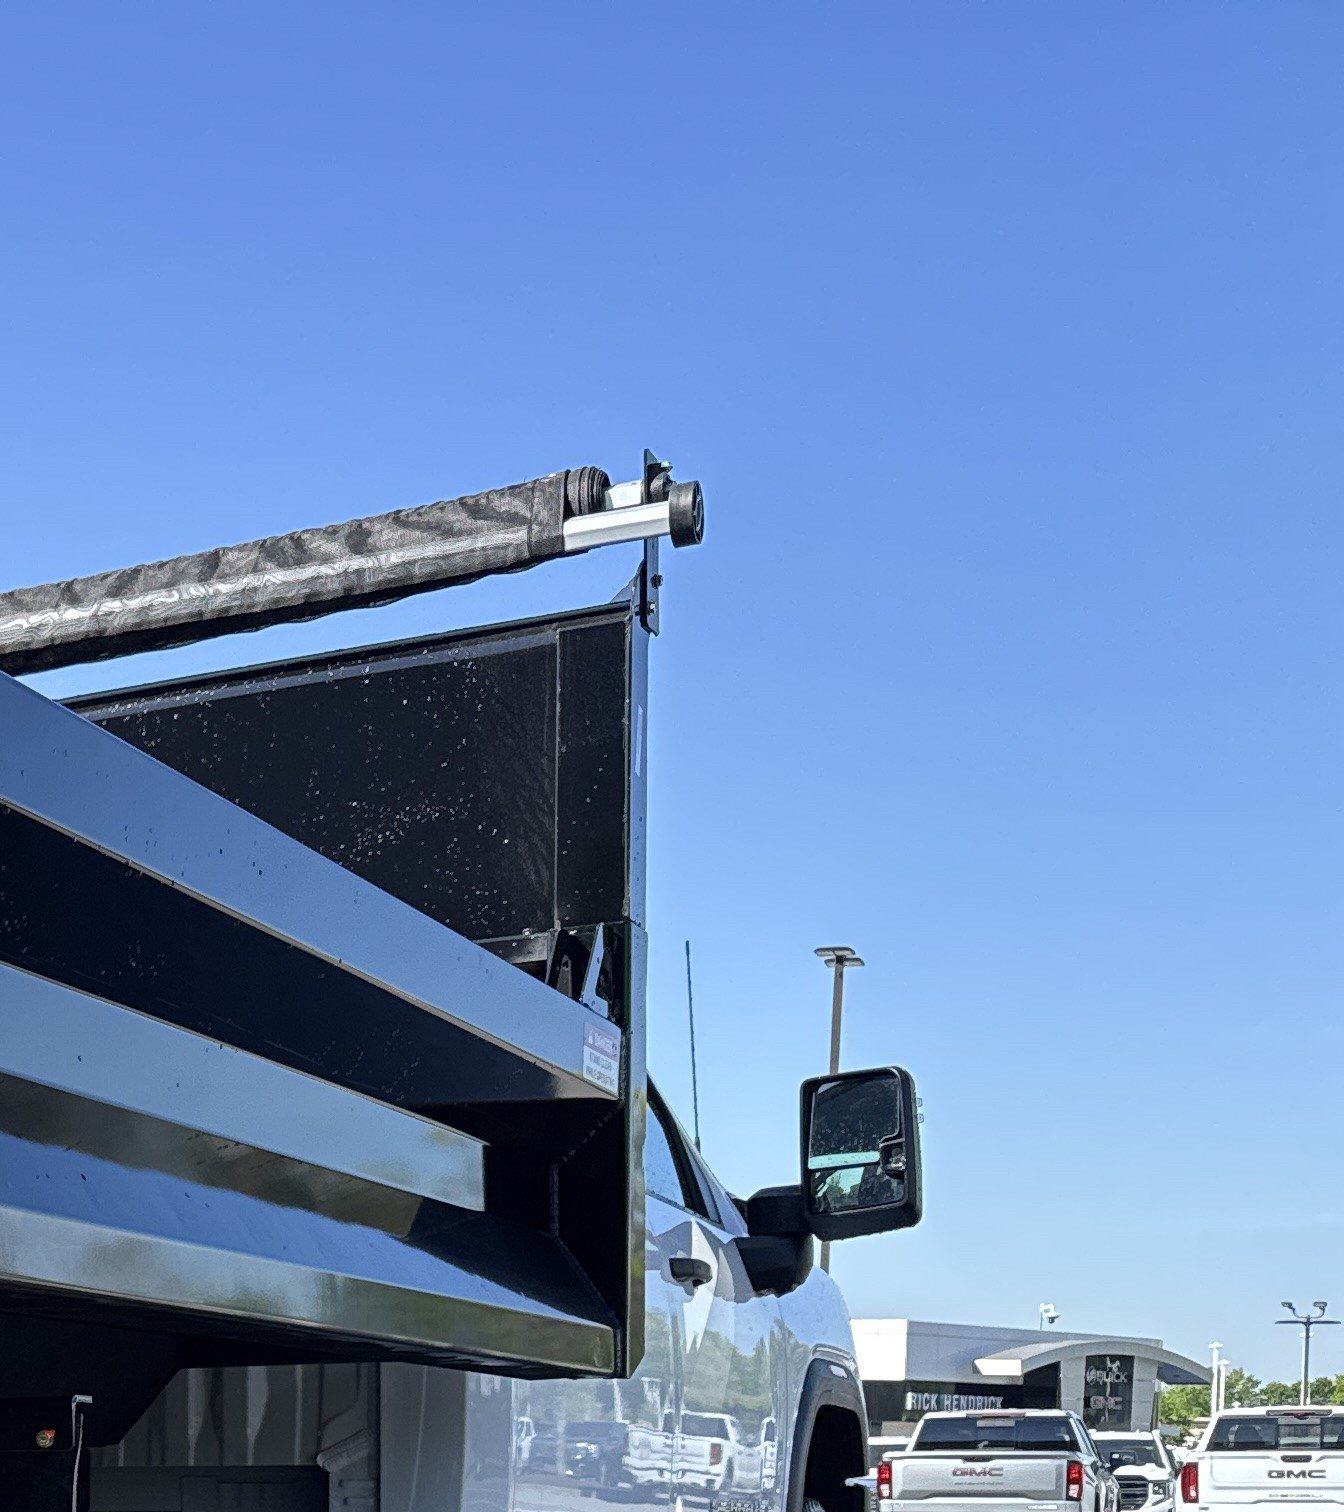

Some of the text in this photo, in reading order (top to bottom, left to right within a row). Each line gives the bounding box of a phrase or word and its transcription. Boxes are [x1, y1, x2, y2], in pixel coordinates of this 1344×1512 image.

[906, 1391, 1003, 1411] RICK HENDRICK
[952, 1467, 1004, 1477] GMC
[1267, 1469, 1327, 1479] GMC
